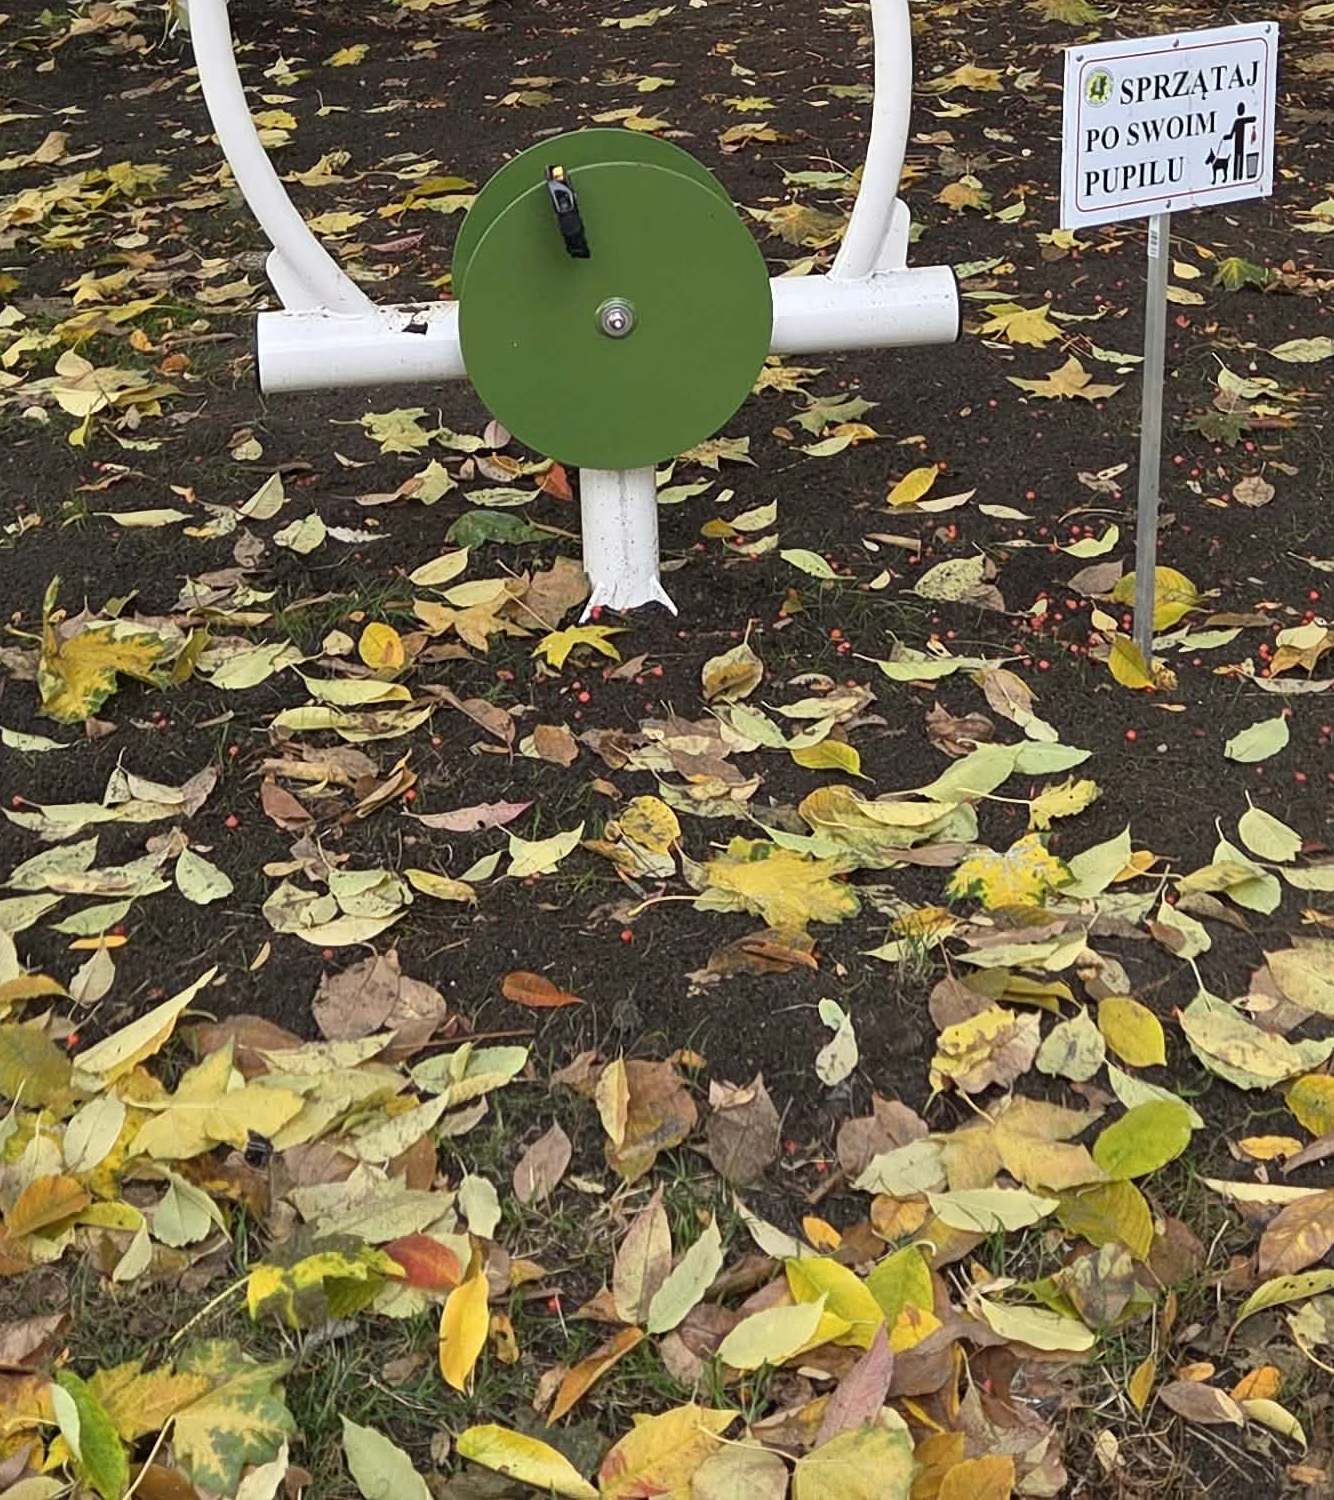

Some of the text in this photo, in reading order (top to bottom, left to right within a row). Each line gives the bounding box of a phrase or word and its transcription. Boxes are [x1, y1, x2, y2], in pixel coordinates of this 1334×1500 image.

[1119, 61, 1260, 105] SPRZĄTAJ
[1085, 111, 1218, 152] PO SWOIM
[1084, 156, 1184, 196] PUPILU
